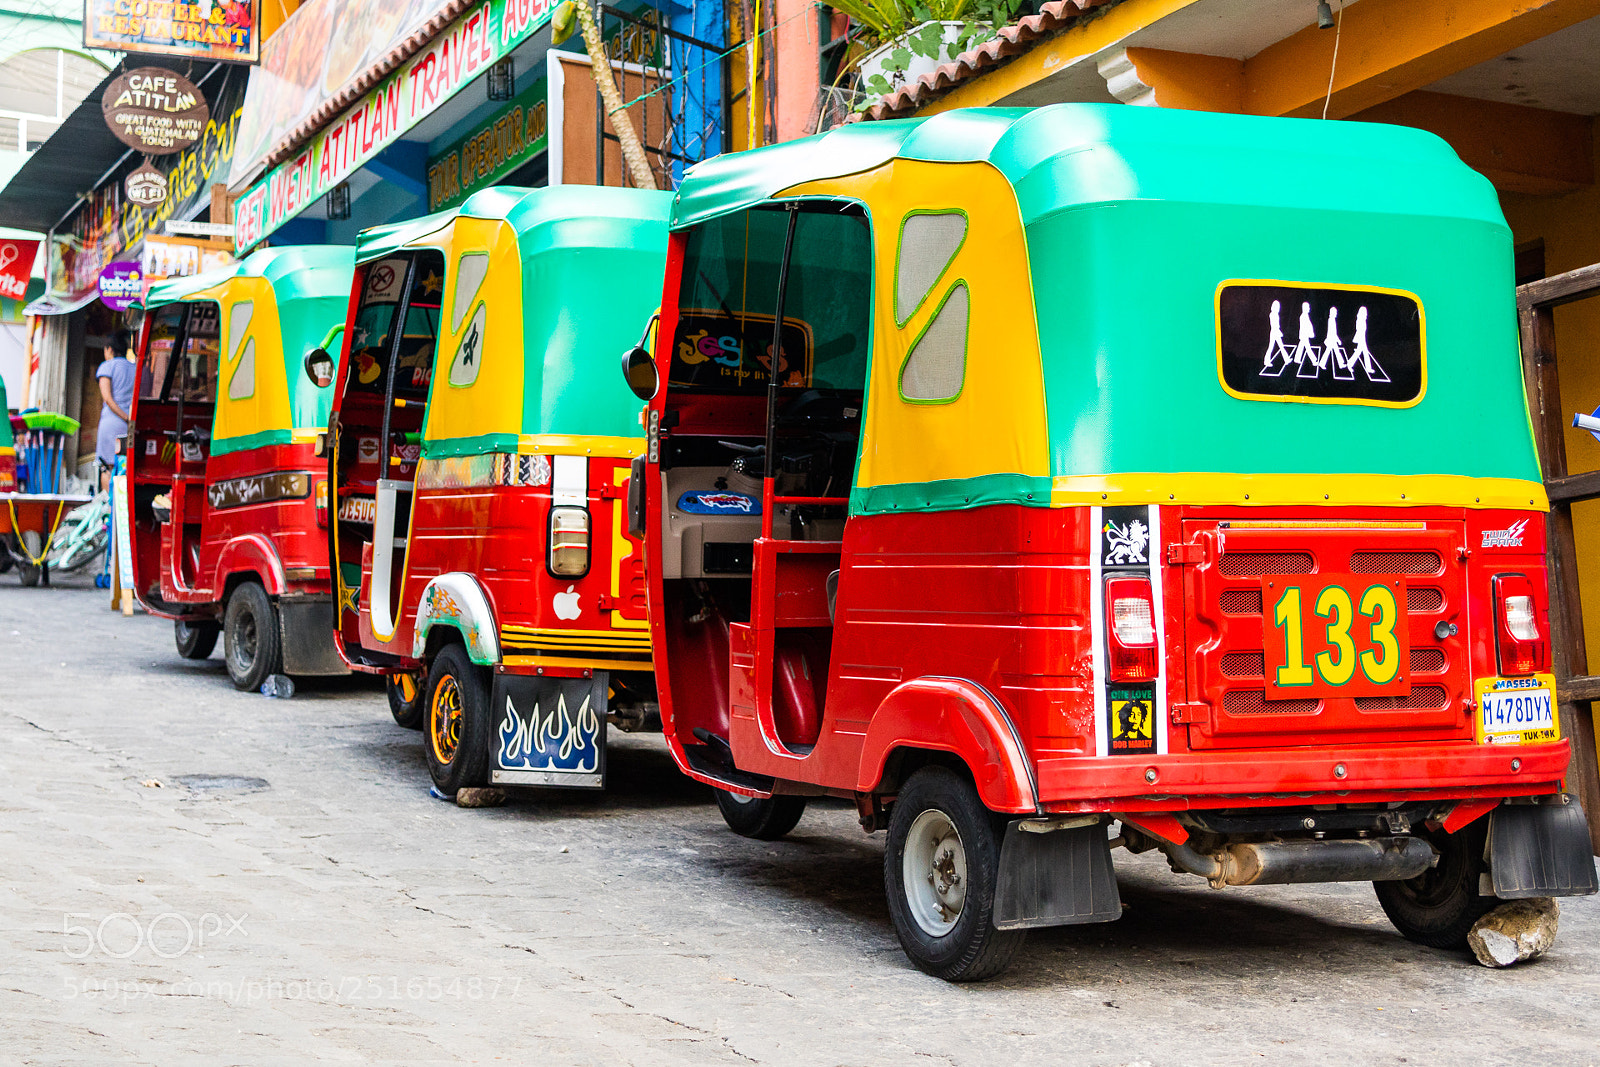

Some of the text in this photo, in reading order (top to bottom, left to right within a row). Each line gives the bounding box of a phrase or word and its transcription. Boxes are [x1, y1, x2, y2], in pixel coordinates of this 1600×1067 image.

[209, 7, 226, 25] &
[98, 14, 247, 47] RESTAURANT
[129, 75, 178, 93] CAFE
[115, 113, 202, 131] GREAT FOOD WITH
[235, 183, 267, 250] GET
[270, 147, 313, 224] WET!
[317, 77, 400, 190] ATITLAN
[409, 3, 491, 118] TRAVEL
[124, 124, 199, 141] A GUATEMALAN
[141, 136, 174, 148] TOUCH
[428, 151, 459, 214] TOUR
[461, 104, 524, 191] OPERATOR
[1481, 530, 1511, 539] TWIN
[1481, 538, 1524, 548] SPARK
[1274, 583, 1401, 687] 133
[1496, 678, 1538, 689] MASESA
[1110, 690, 1152, 699] ONE LOVE
[1112, 740, 1153, 749] BOB MARLEY
